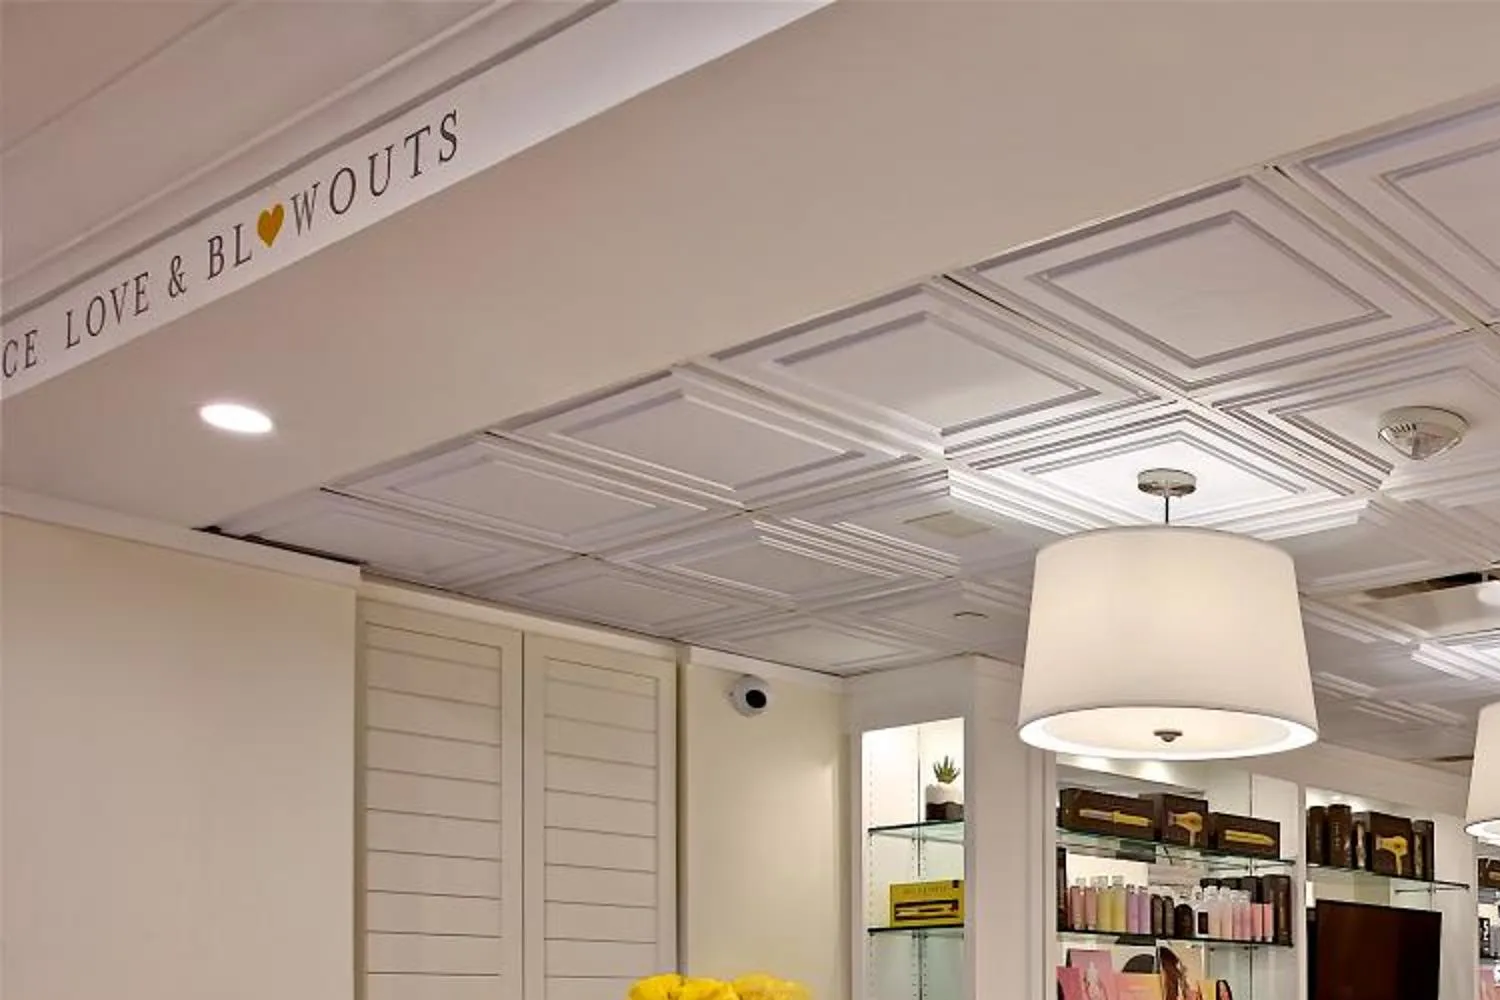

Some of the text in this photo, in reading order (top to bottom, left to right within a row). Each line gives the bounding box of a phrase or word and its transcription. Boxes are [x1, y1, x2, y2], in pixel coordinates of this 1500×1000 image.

[65, 271, 151, 349] LOVE
[167, 255, 188, 299] &
[206, 109, 461, 281] BLWOUTS
